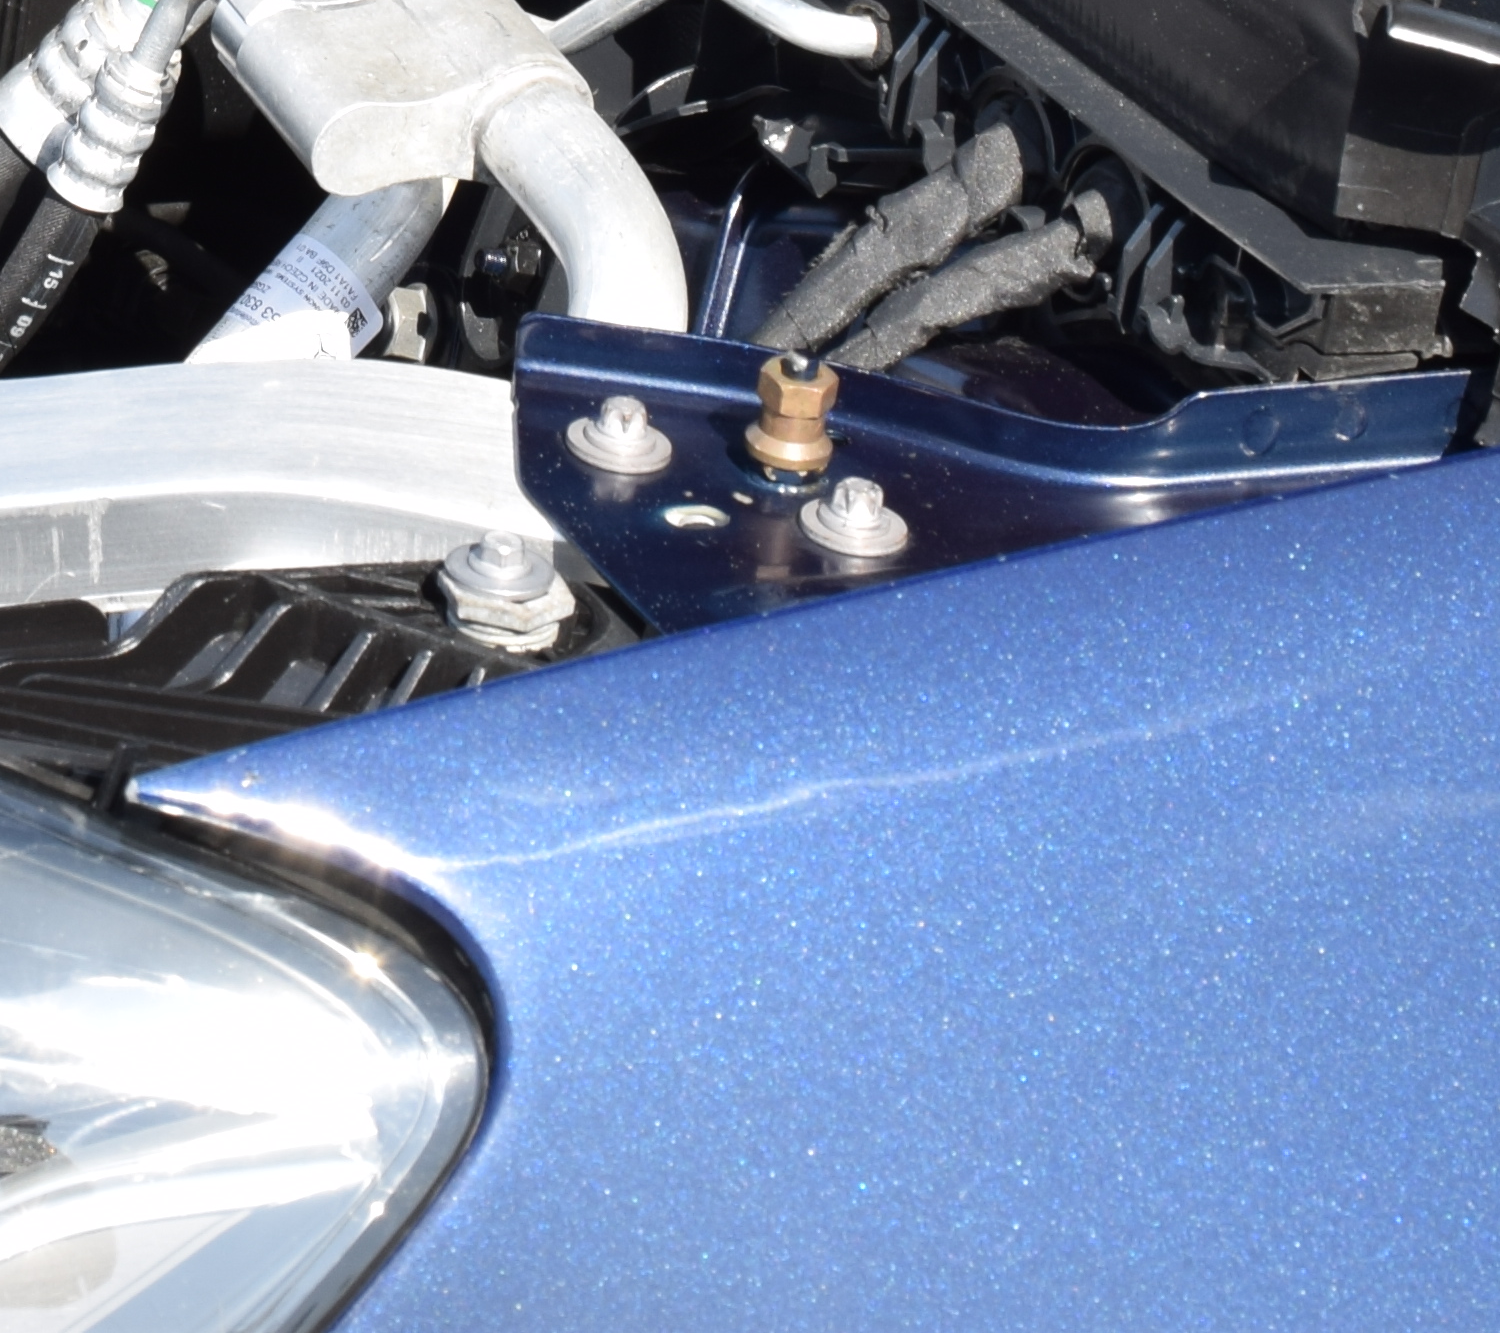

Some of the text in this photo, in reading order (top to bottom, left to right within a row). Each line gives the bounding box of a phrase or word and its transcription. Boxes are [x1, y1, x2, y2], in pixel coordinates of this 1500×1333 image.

[43, 269, 64, 290] 15
[307, 281, 319, 292] IN
[10, 314, 33, 338] 09
